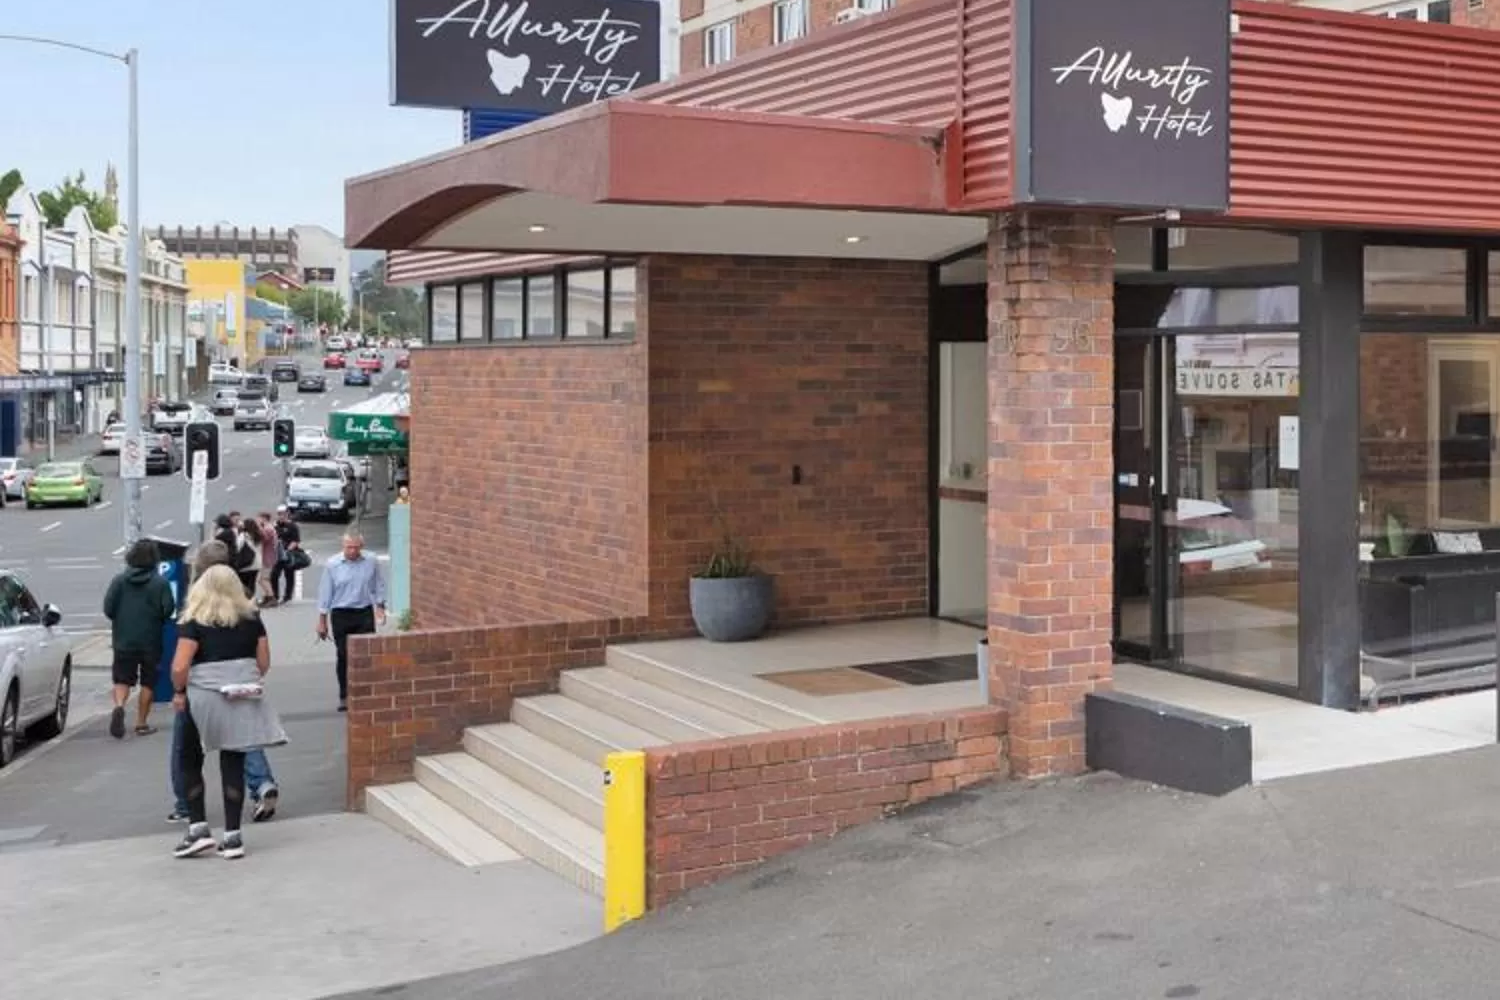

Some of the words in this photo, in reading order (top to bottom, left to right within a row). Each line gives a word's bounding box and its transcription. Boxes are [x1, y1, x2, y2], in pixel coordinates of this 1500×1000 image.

[536, 64, 641, 103] Hotel
[1050, 47, 1213, 105] Allurity
[1136, 104, 1213, 140] Hotel
